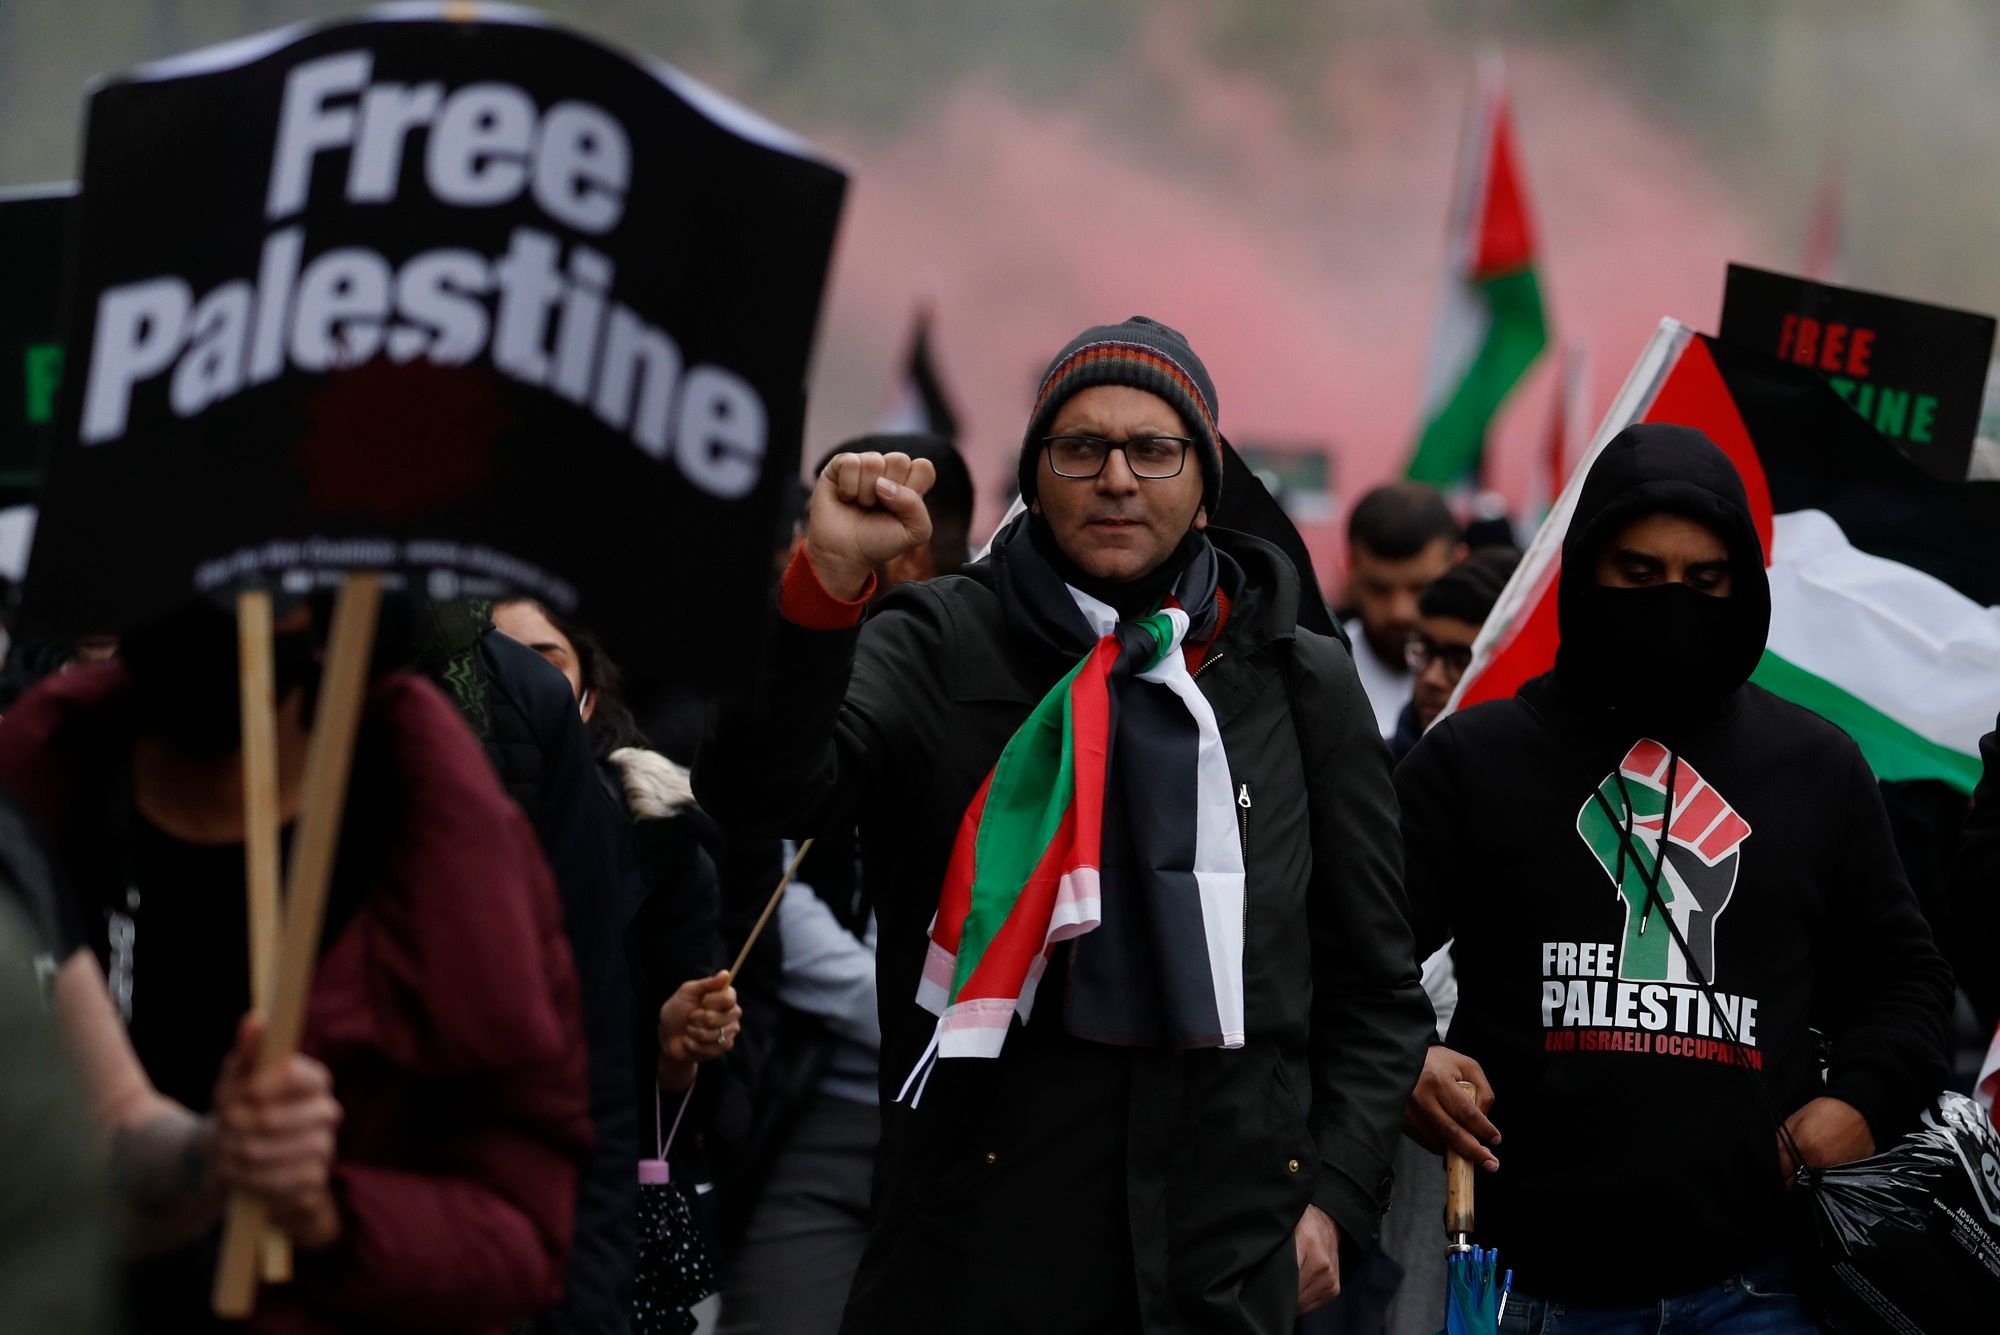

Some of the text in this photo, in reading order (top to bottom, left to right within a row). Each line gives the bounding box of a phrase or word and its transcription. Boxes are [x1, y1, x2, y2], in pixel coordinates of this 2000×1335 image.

[265, 48, 632, 235] Free
[79, 225, 768, 500] Palestine
[1778, 314, 1876, 377] FREE
[1542, 942, 1614, 977] FREE
[1541, 980, 1758, 1047] PALESTINE
[1545, 1030, 1575, 1051] END
[1580, 1030, 1651, 1053] ISRAELI
[1956, 1207, 2000, 1258] JDSPORTS.CO
